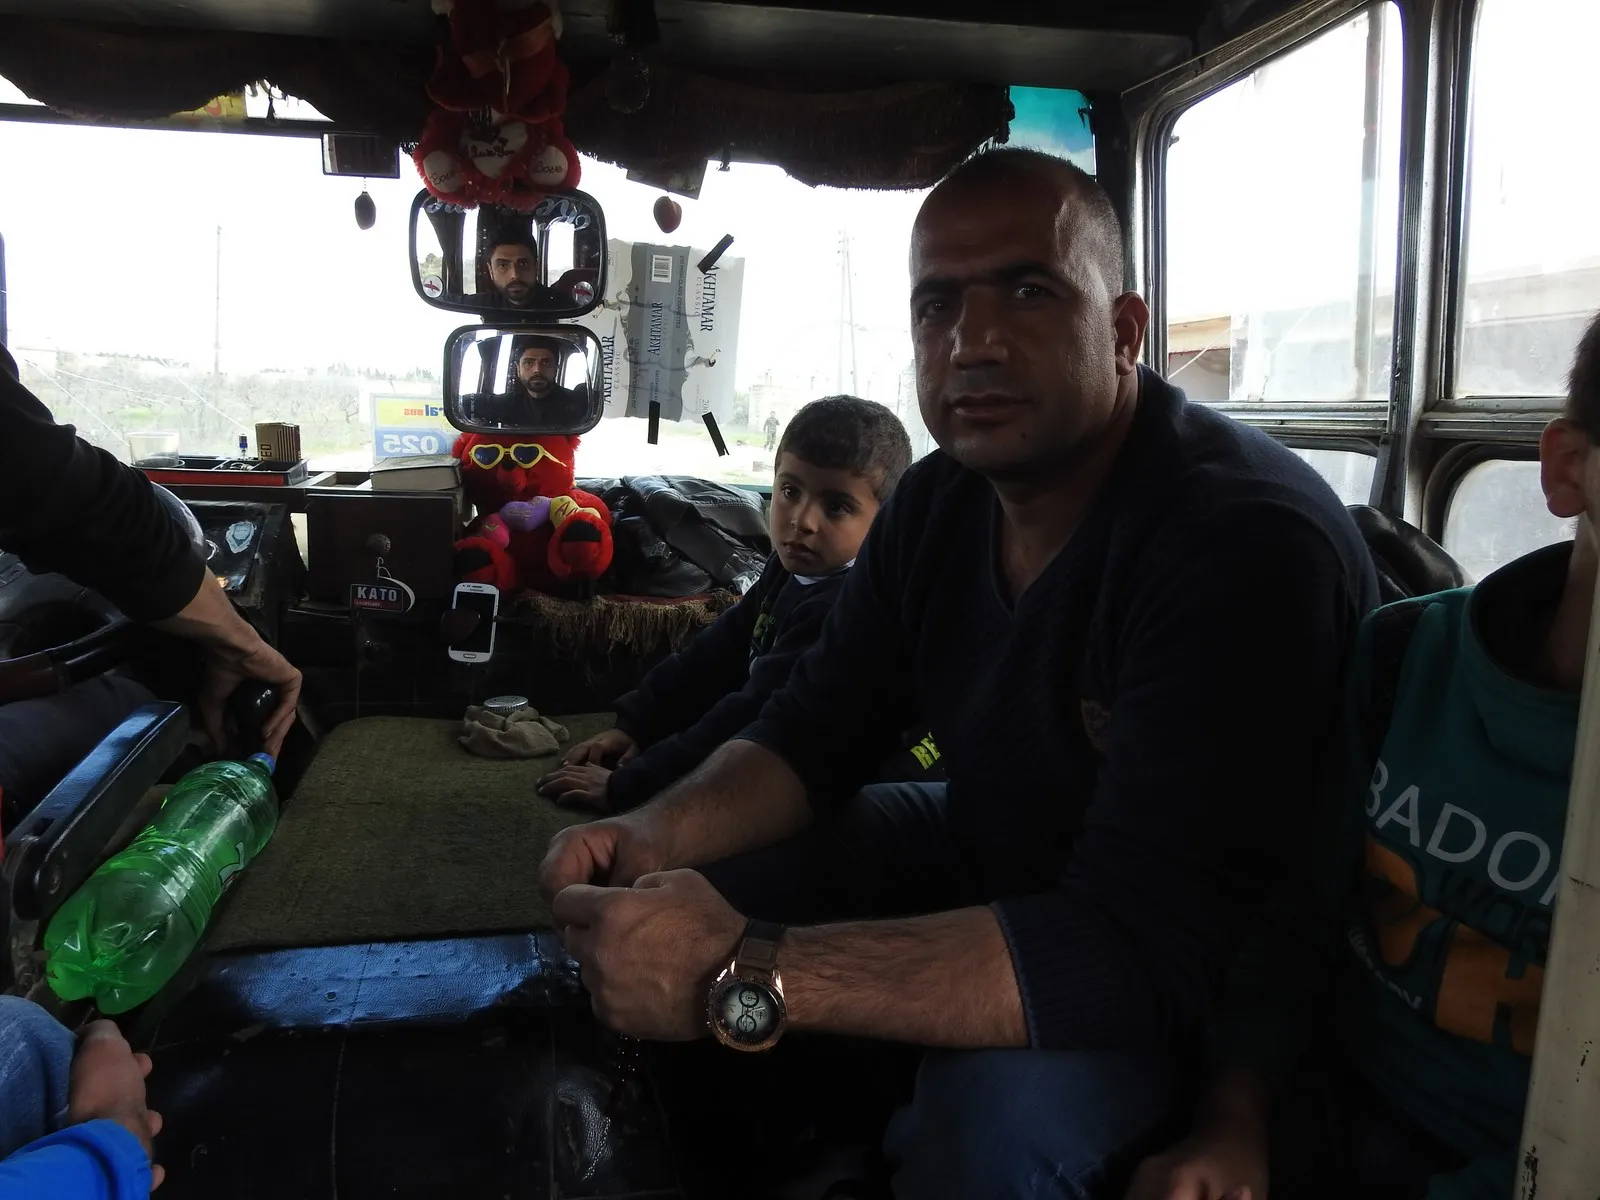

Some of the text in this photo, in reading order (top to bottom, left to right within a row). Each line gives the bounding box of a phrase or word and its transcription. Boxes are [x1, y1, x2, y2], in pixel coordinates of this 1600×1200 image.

[700, 265, 720, 332] AKHTAMAR
[647, 302, 663, 355] AKHTAMAR
[613, 352, 621, 389] CLASSIC
[357, 587, 397, 602] KATO
[1365, 758, 1562, 906] BADO
